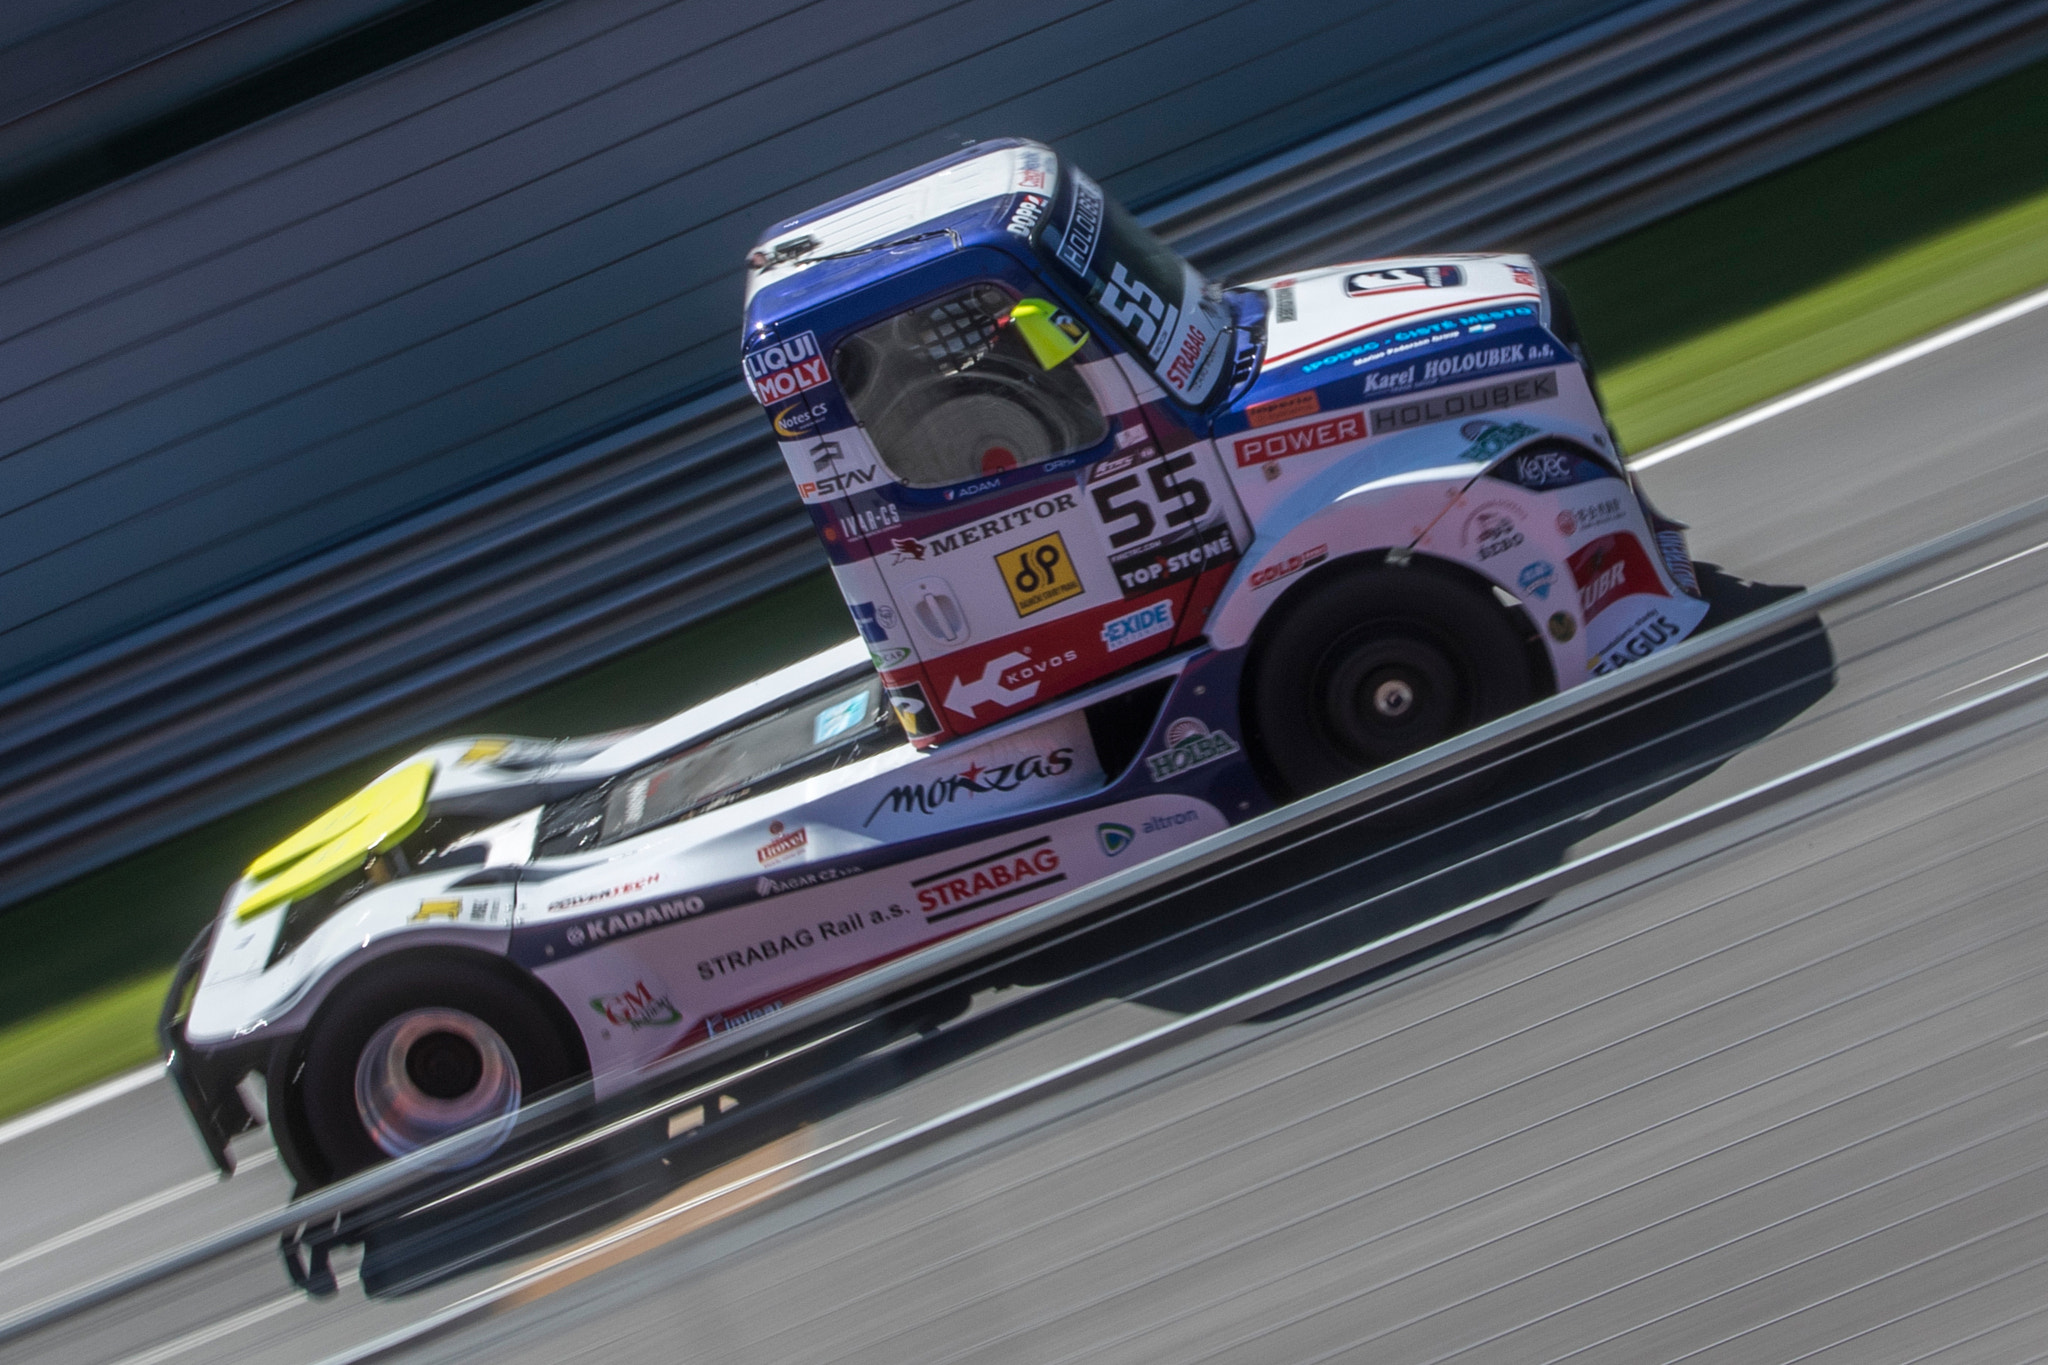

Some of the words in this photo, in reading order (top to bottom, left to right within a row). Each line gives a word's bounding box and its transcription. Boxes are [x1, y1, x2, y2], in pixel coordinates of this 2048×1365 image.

[1100, 261, 1165, 347] 55
[749, 335, 816, 378] LIQUI
[1166, 324, 1207, 390] STRABAG
[1363, 366, 1415, 393] Karel
[1423, 345, 1524, 380] HOLOUBEK
[1528, 343, 1555, 361] a.s.
[757, 359, 823, 402] MOLY
[1374, 376, 1553, 427] HOLOUBEK
[777, 411, 811, 431] Notes
[812, 403, 829, 419] CS
[1243, 419, 1358, 462] POWER
[958, 478, 1001, 497] ADAM
[1091, 451, 1212, 549] 55
[839, 503, 901, 538] IVAR-CS
[930, 492, 1079, 557] MERITOR
[1121, 563, 1163, 588] TOP
[1166, 536, 1233, 573] STONE
[1104, 602, 1169, 641] EXIDE
[1005, 650, 1078, 684] KOVOS
[1152, 732, 1234, 778] HOLBA
[1141, 806, 1199, 834] altron
[916, 848, 1061, 913] STRABAG
[586, 896, 705, 941] KADAMO
[697, 929, 815, 982] STRABAG
[818, 914, 864, 941] Rail
[870, 904, 911, 927] a.s.
